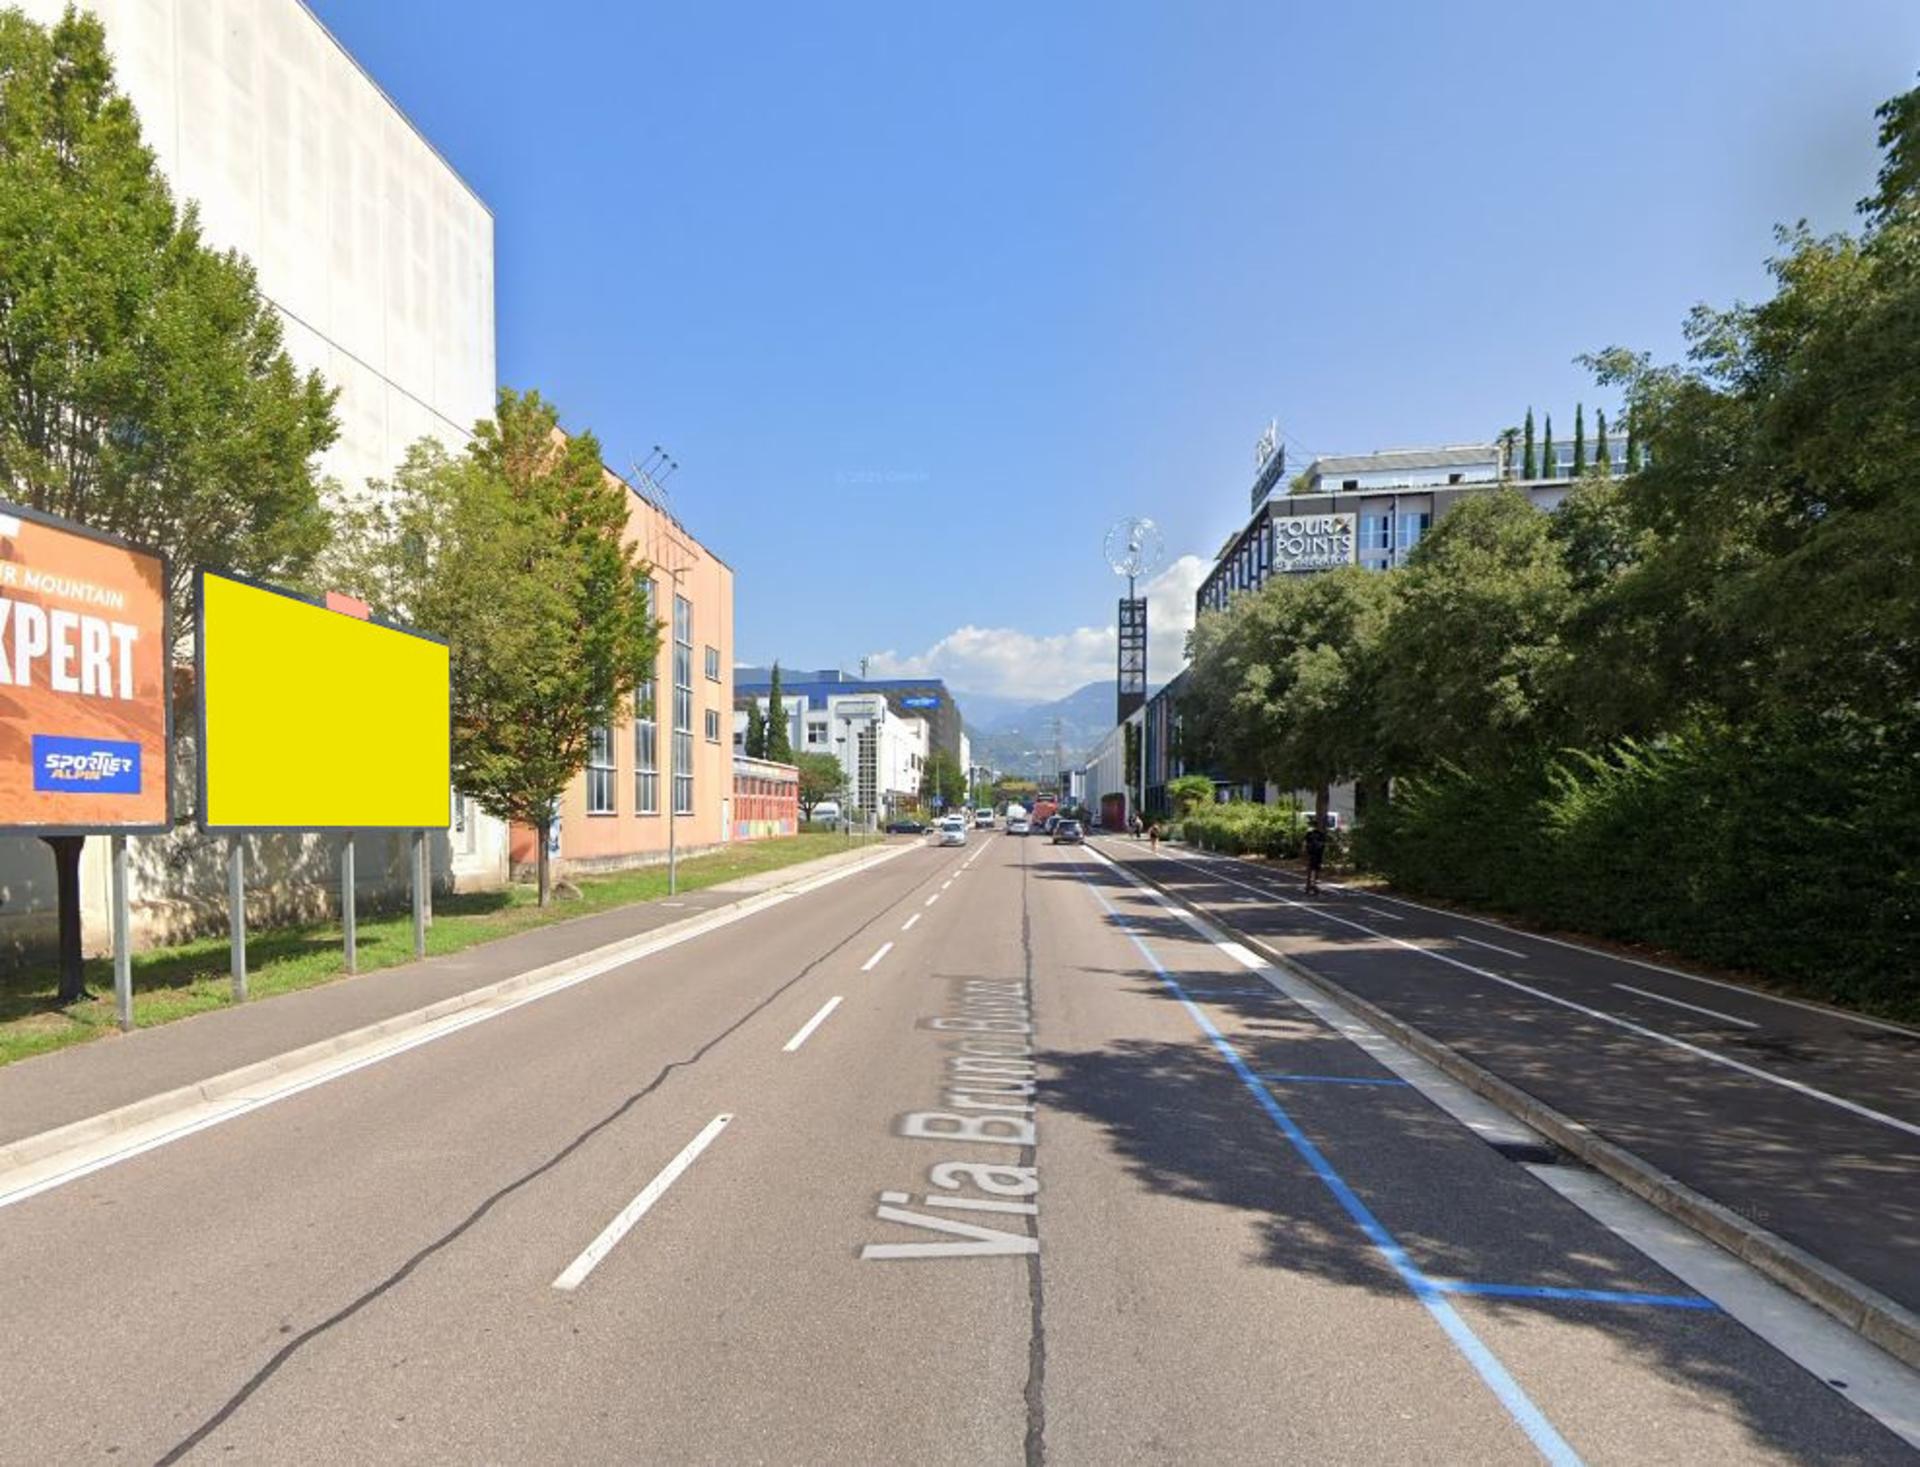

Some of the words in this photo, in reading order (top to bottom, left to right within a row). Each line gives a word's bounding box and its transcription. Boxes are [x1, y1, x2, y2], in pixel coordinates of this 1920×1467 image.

[1276, 518, 1333, 537] FOUR
[1276, 535, 1352, 555] POINTS
[25, 567, 124, 609] MOUNTAIN
[45, 751, 132, 777] SPORTLER
